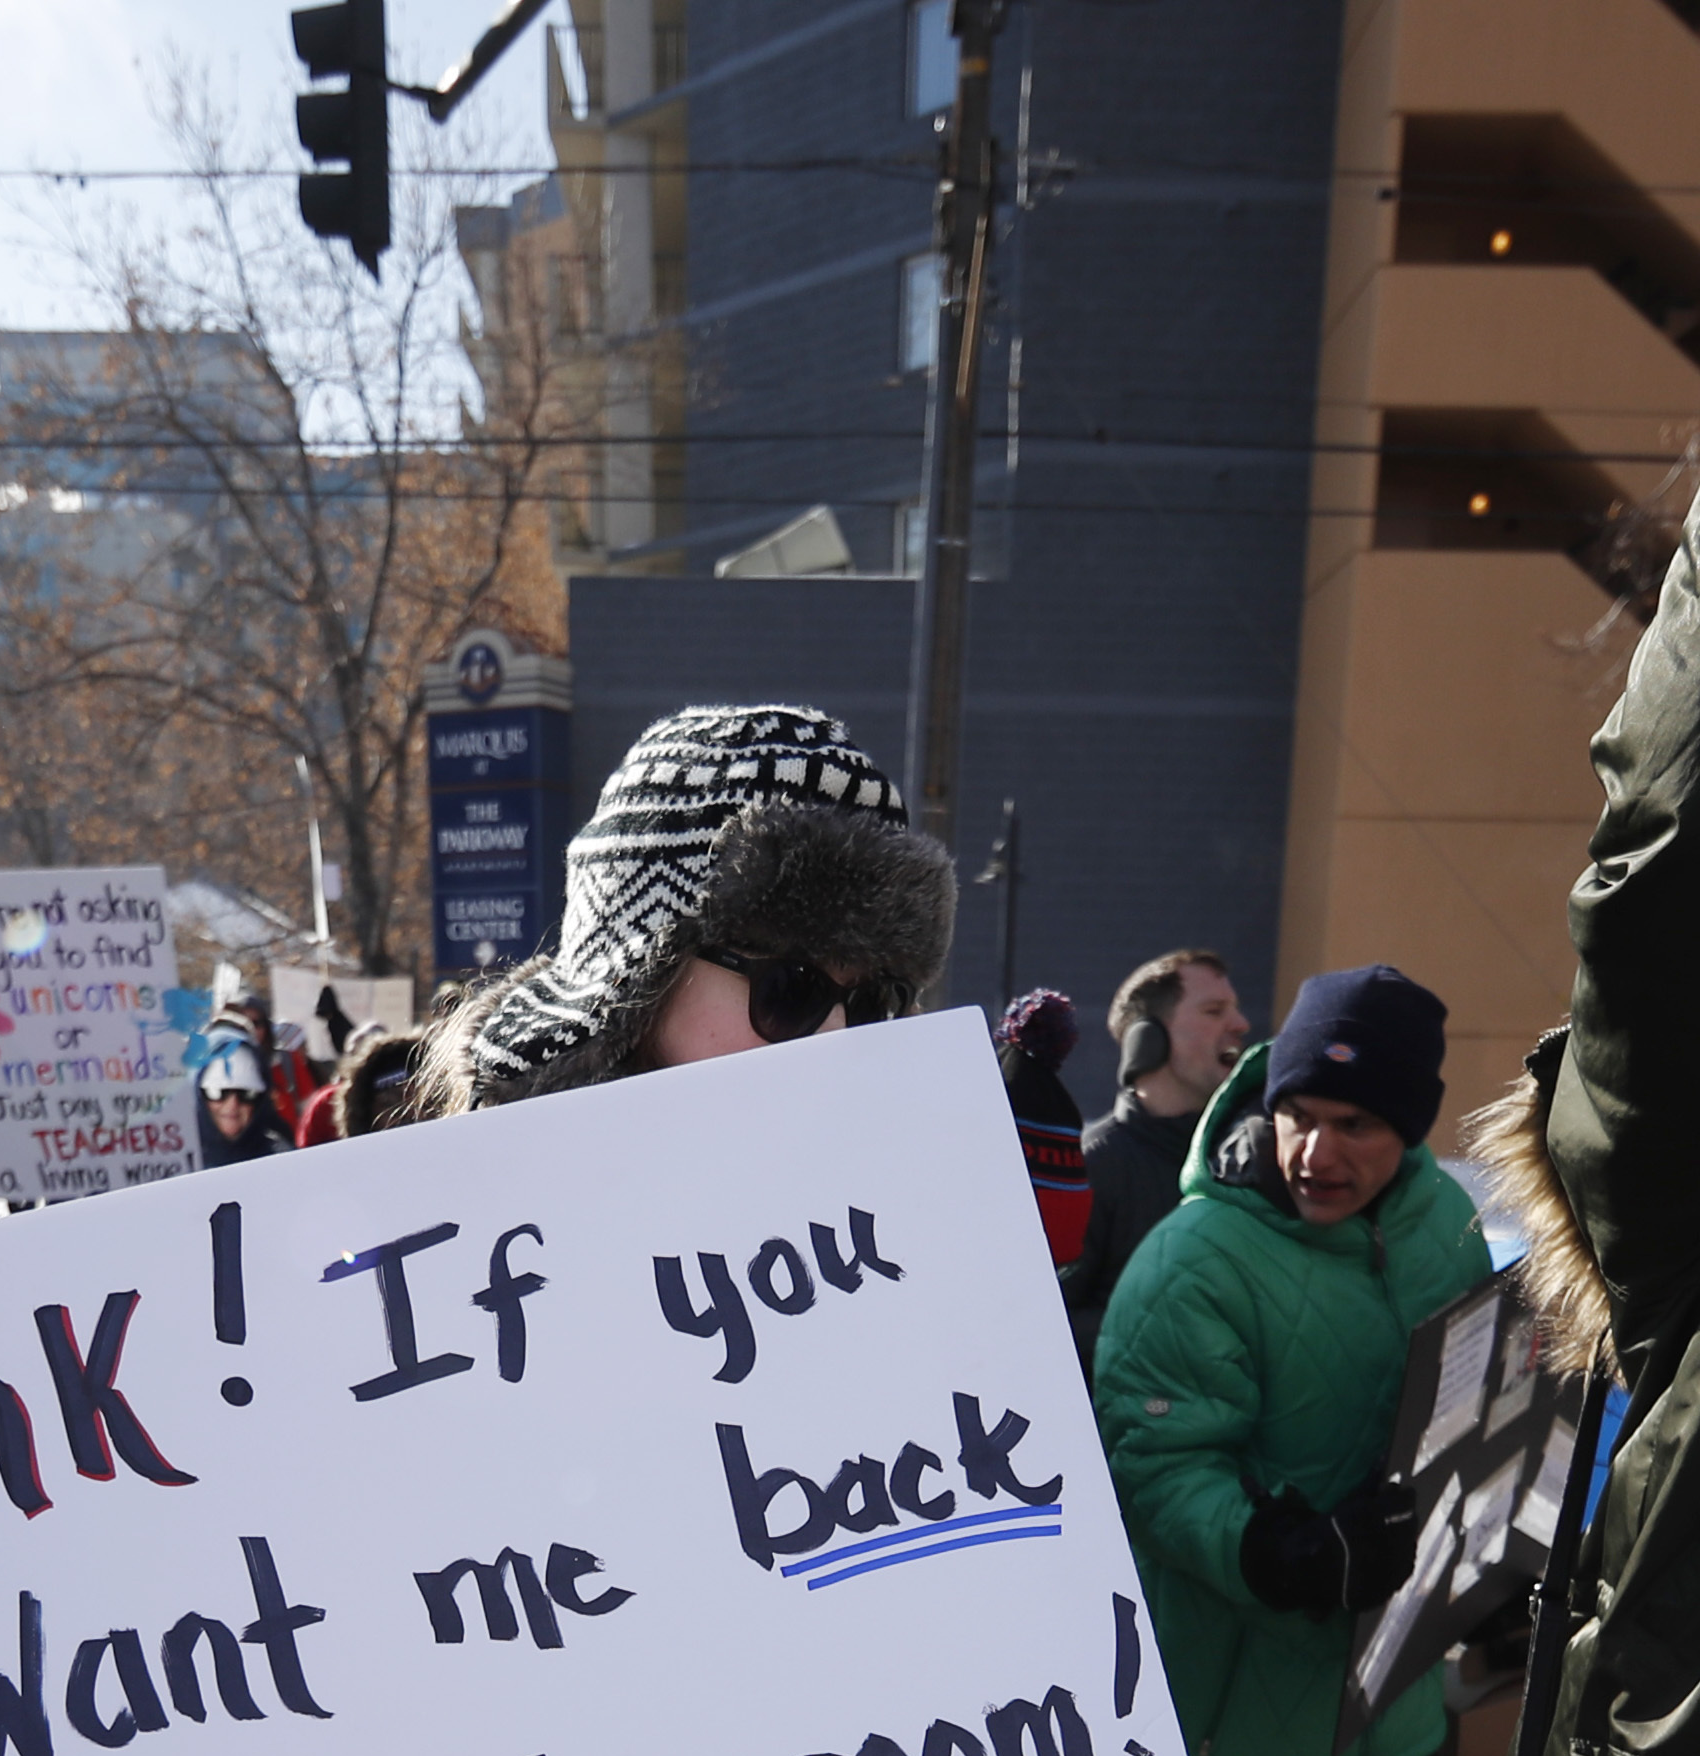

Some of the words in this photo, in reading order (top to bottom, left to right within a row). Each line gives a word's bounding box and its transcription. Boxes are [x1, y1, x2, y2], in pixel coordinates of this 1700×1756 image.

[78, 882, 166, 946] asking
[53, 937, 87, 970] to
[93, 931, 154, 969] find
[11, 979, 158, 1017] unicorns
[54, 1024, 90, 1051] or
[58, 1099, 104, 1127] pay
[112, 1092, 166, 1128] your
[32, 1121, 185, 1163] TEACHERS
[0, 1171, 19, 1193] a
[36, 1160, 110, 1192] living
[322, 1222, 547, 1402] If
[654, 1205, 906, 1383] you
[413, 1541, 636, 1652] me
[715, 1392, 1065, 1572] back
